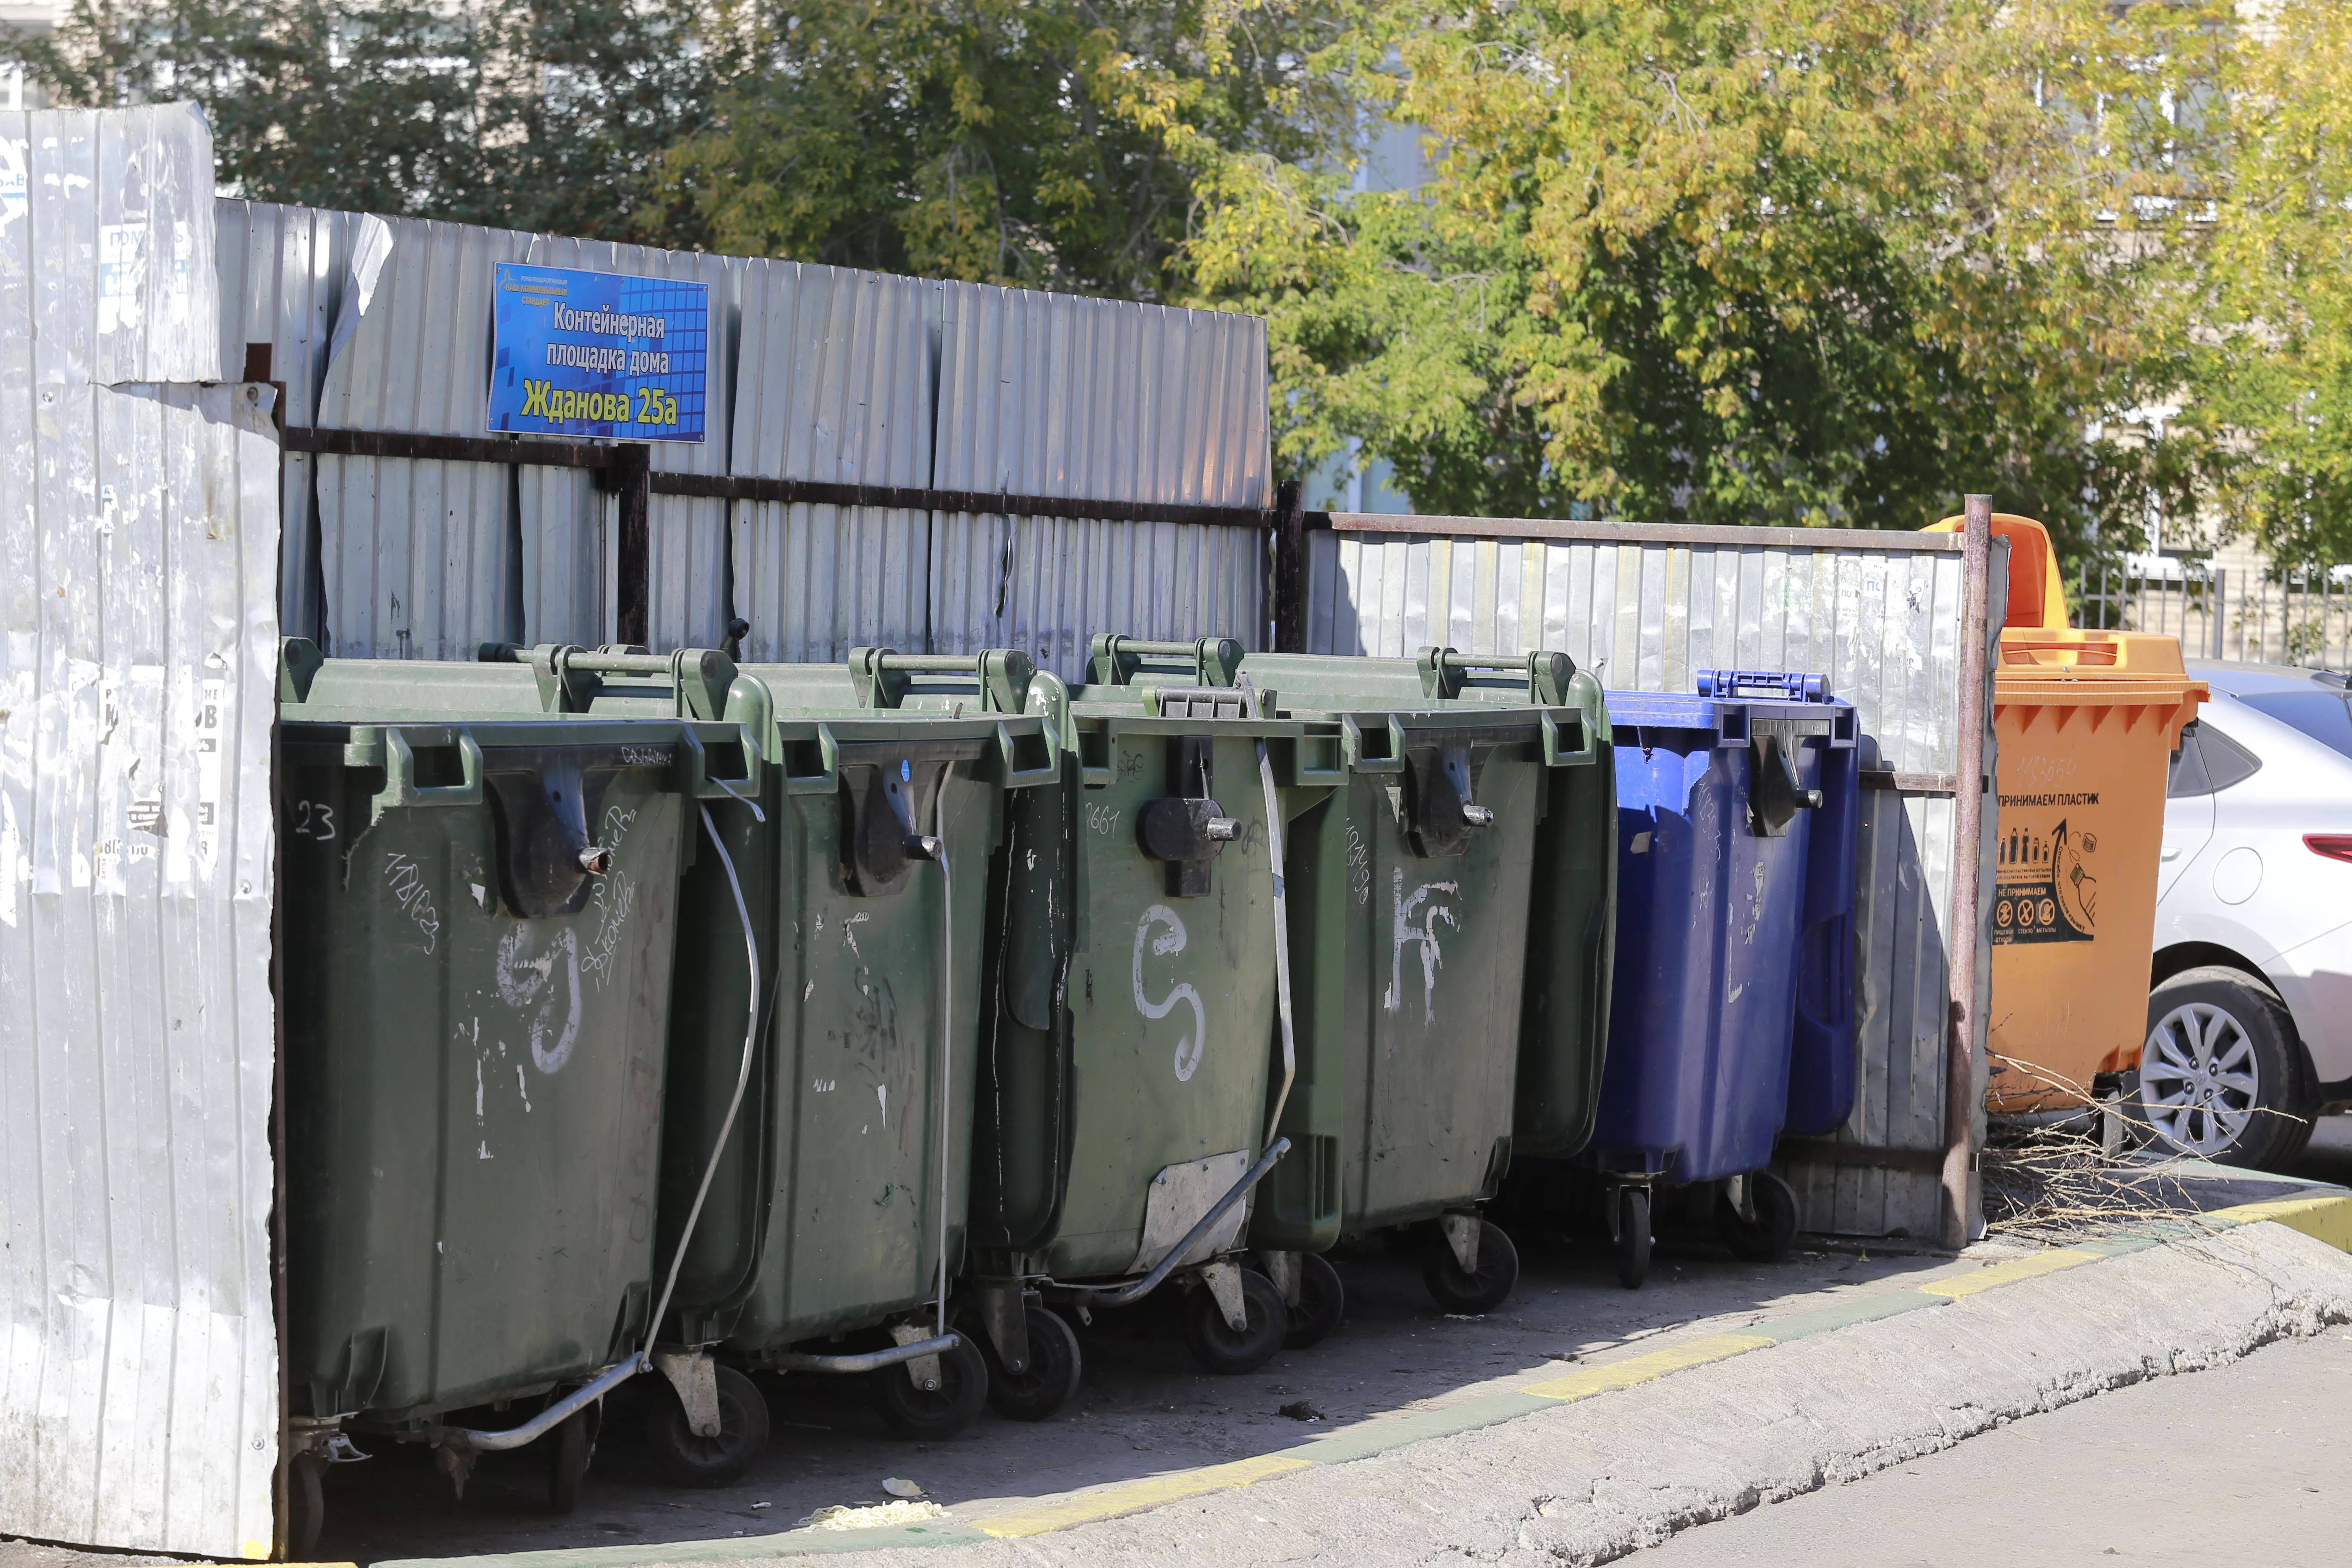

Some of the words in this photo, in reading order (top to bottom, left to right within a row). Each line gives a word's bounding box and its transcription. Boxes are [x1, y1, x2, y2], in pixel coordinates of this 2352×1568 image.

[521, 285, 567, 297] КОММУНАЛЬНЫЙ
[554, 301, 665, 342] Контейнерная
[547, 343, 625, 374] площадка
[629, 350, 669, 376] дома
[520, 379, 630, 424] Жданова
[637, 386, 677, 425] 25а
[1999, 794, 2055, 807] ПРИНИМАЕМ
[2058, 793, 2099, 805] ПЛАСТИК
[295, 800, 335, 840] 23
[1998, 888, 2006, 897] НЕ
[2007, 887, 2046, 897] ПРИНИМАЕМ
